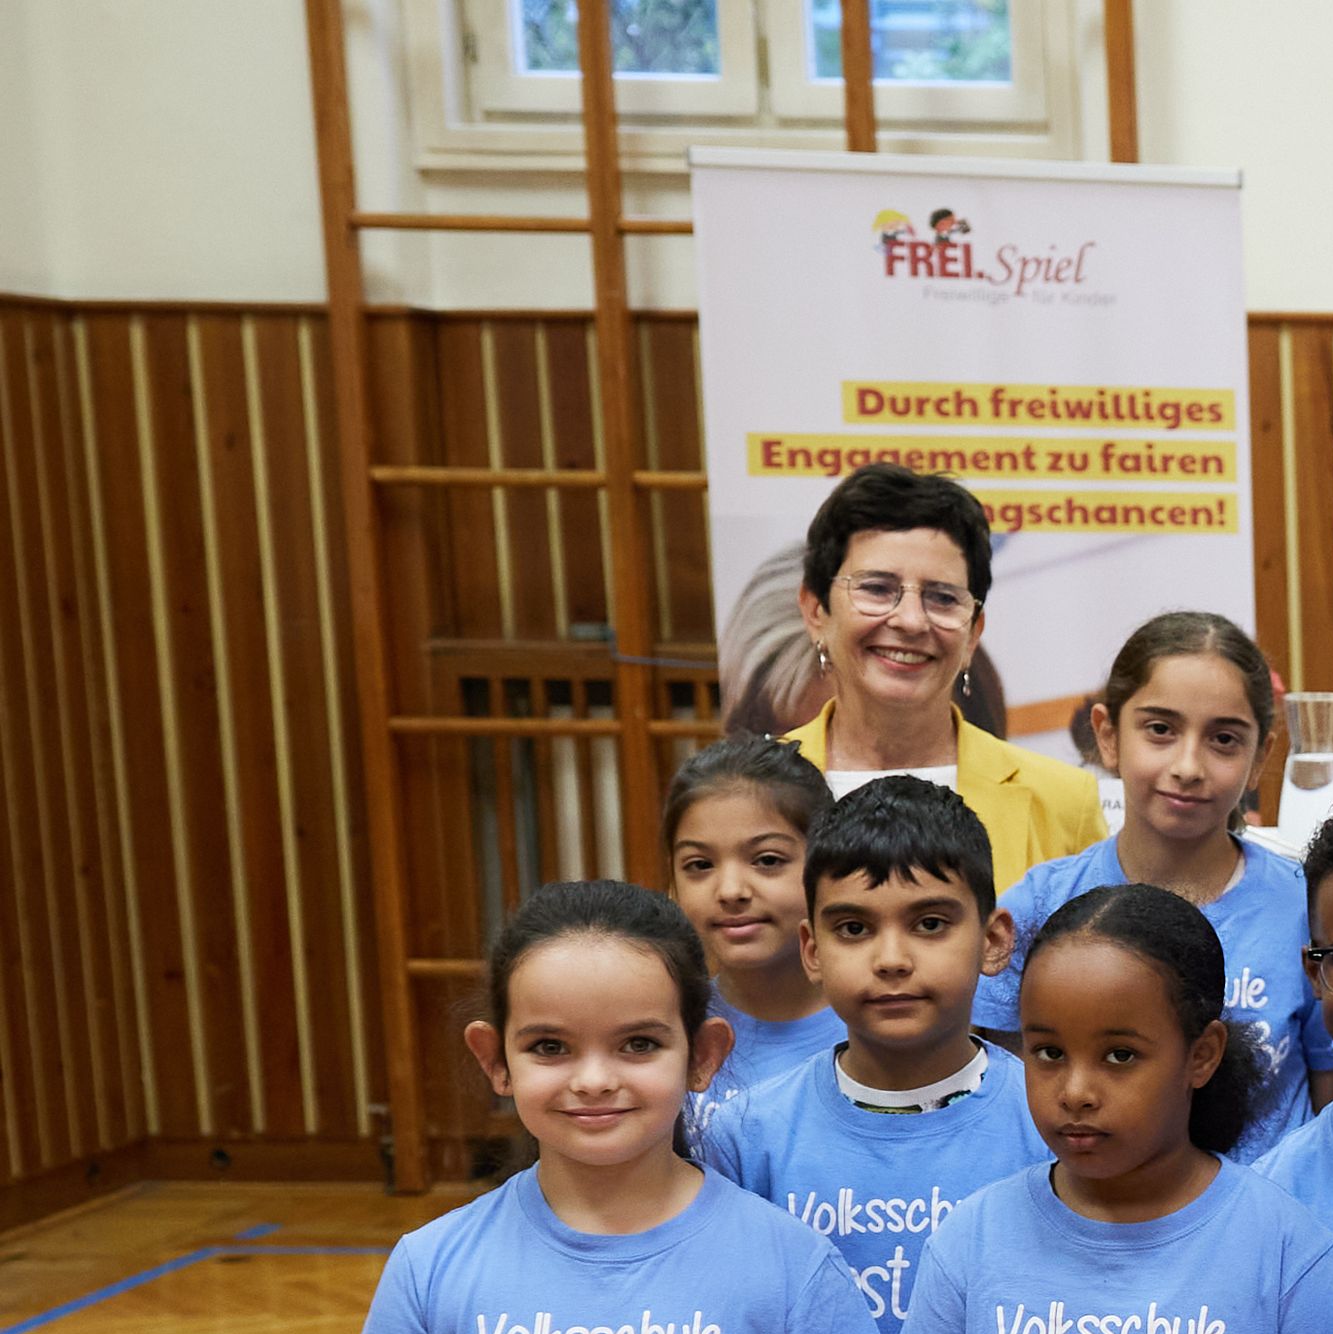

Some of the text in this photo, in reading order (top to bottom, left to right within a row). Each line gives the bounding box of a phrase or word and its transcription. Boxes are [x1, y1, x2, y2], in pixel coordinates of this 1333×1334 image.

[856, 387, 1224, 430] Durch freiwilliges
[1047, 446, 1090, 472] zu
[1100, 441, 1225, 476] fairen
[787, 1186, 962, 1236] Volkssch
